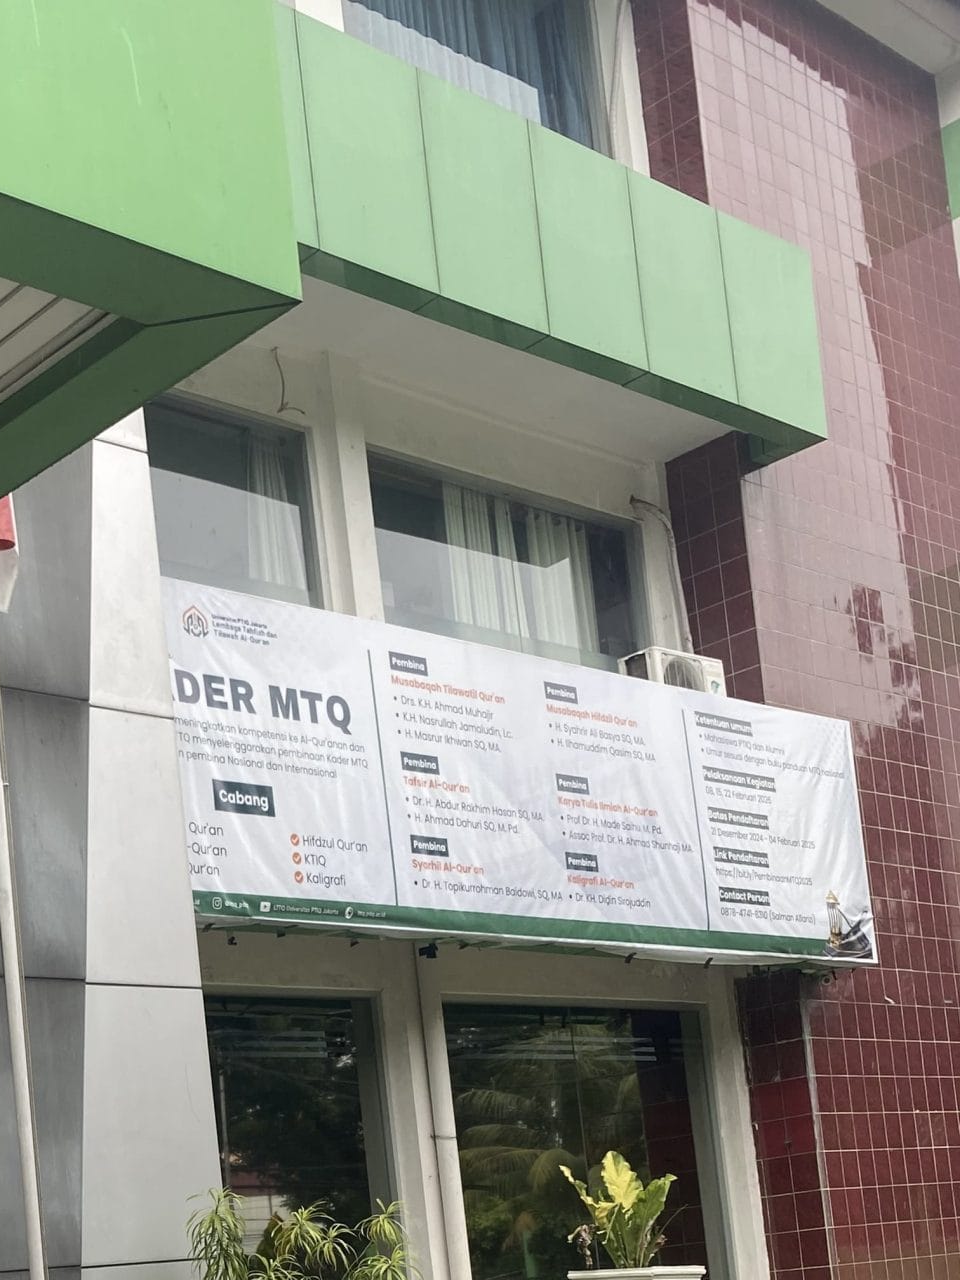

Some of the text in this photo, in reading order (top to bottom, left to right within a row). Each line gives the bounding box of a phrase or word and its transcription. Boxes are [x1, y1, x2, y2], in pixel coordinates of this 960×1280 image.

[212, 621, 278, 639] Lembaga dan
[214, 629, 239, 640] Tilawah
[392, 657, 425, 671] Pembina
[391, 675, 505, 705] Musabaqah Tilawatil Qur'an
[547, 686, 576, 699] Pembina
[173, 668, 352, 736] DER MTQ
[401, 695, 494, 722] Drs. K.H. Ahmad Muhajir
[546, 704, 590, 720] Musabaqah
[614, 716, 638, 728] Qur'an
[403, 711, 418, 723] K.H.
[419, 715, 458, 730] Nasrullah
[459, 721, 502, 738] Jamaludin,
[175, 717, 237, 735] meningkatkan
[238, 726, 287, 741] kompetensi
[288, 734, 299, 743] ke
[349, 743, 365, 753] dan
[405, 729, 414, 738] H.
[415, 730, 442, 743] Masrur
[444, 734, 473, 748] Ikhwan
[193, 736, 277, 755] menyelenggarakan
[278, 747, 325, 763] pembinaan
[327, 753, 350, 765] Kader
[351, 757, 369, 769] MTQ
[610, 746, 632, 758] Qasim
[186, 751, 337, 778] pembina Nasional dan Internasional
[403, 757, 437, 770] Pembina
[404, 776, 471, 794] Tafsir Al-Qur'an
[558, 778, 588, 790] Pembina
[746, 776, 776, 789] Kegiatan
[219, 789, 269, 811] Cabang
[558, 797, 658, 818] Karya Tulis Ilmiah Al-Qur'an
[435, 799, 460, 811] Abdur
[492, 806, 517, 818] Hasan
[189, 821, 224, 836] Qur'an
[425, 815, 454, 826] Ahmad
[456, 818, 482, 830] Dahuri
[601, 819, 620, 829] Made
[717, 828, 748, 840] Desember
[302, 835, 368, 852] Hifdzul Qur'an
[413, 839, 446, 852] Pembina
[626, 837, 650, 848] Ahmad
[304, 854, 327, 867] KTIQ
[412, 859, 484, 876] Syarhil Al-Qur'an
[567, 856, 596, 868] Pembina
[306, 872, 346, 888] Kaligrafi
[568, 875, 635, 890] Kaligrafi Al-Qur'an
[720, 889, 770, 903] Contact Person
